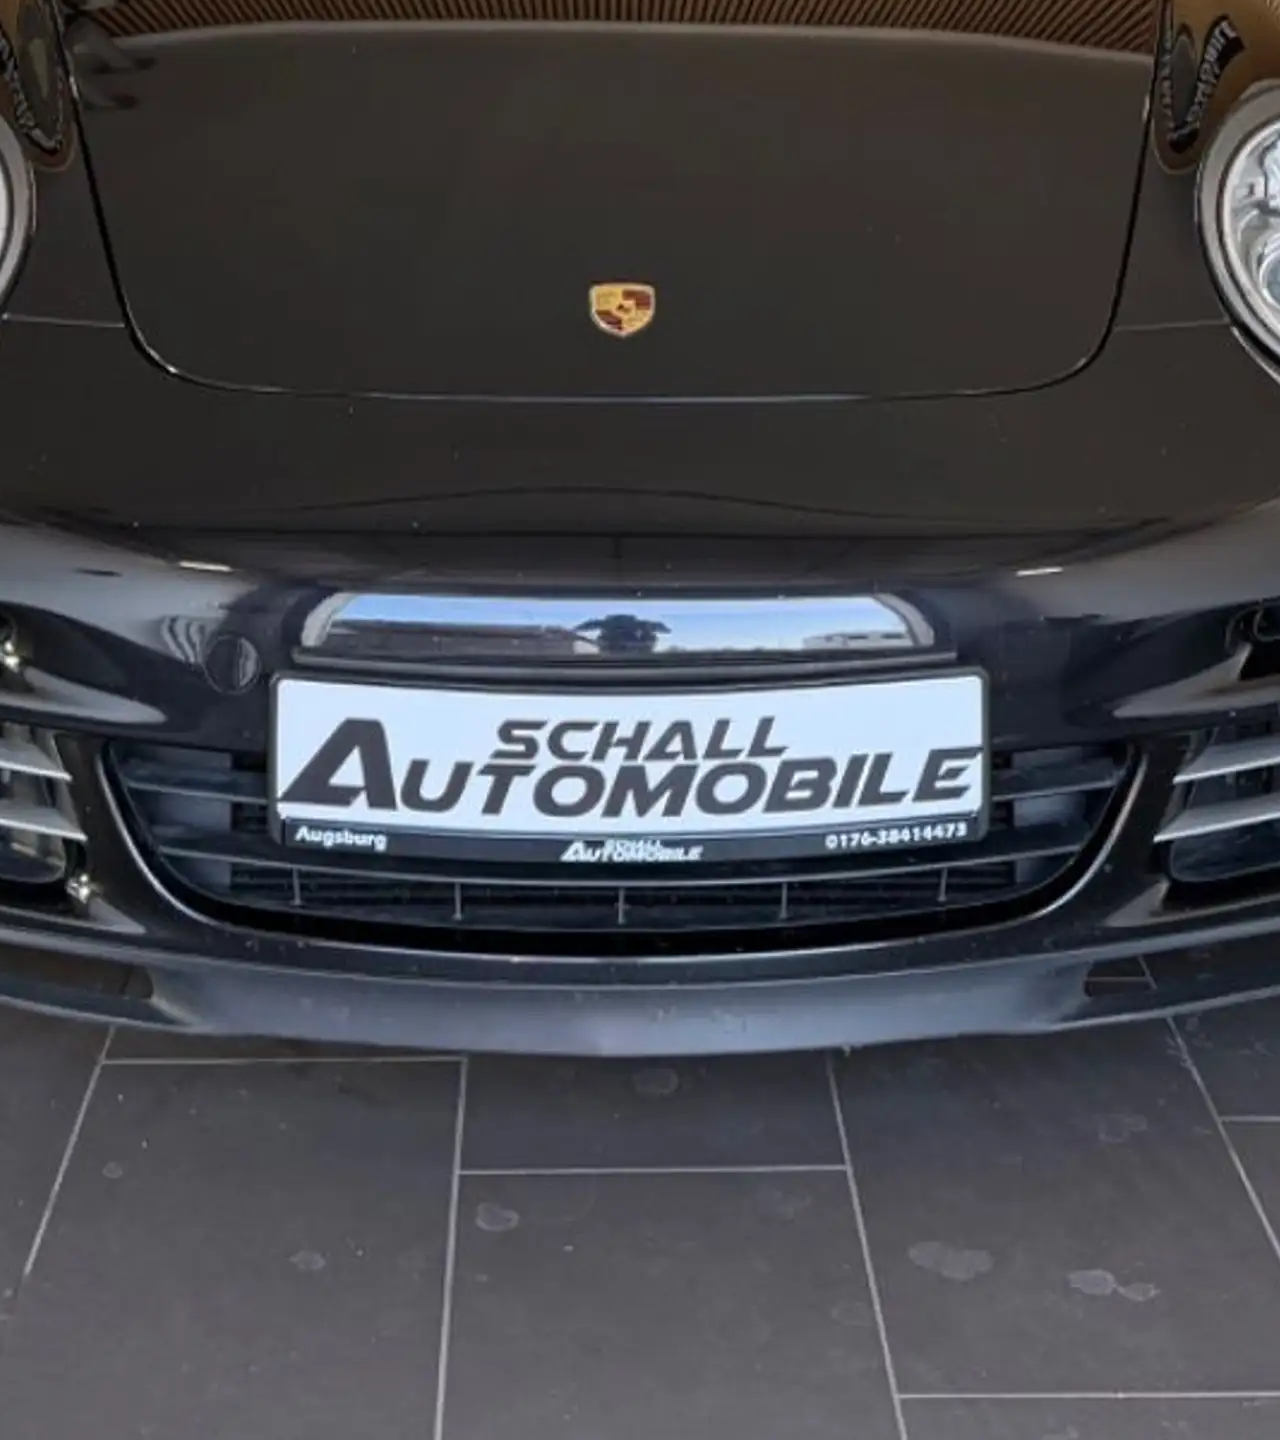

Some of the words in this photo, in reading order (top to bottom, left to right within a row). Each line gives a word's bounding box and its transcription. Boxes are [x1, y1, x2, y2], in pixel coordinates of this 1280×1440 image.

[490, 716, 789, 762] SCHALL
[277, 717, 983, 818] AUTOMOBILE
[295, 825, 387, 852] Augsburg
